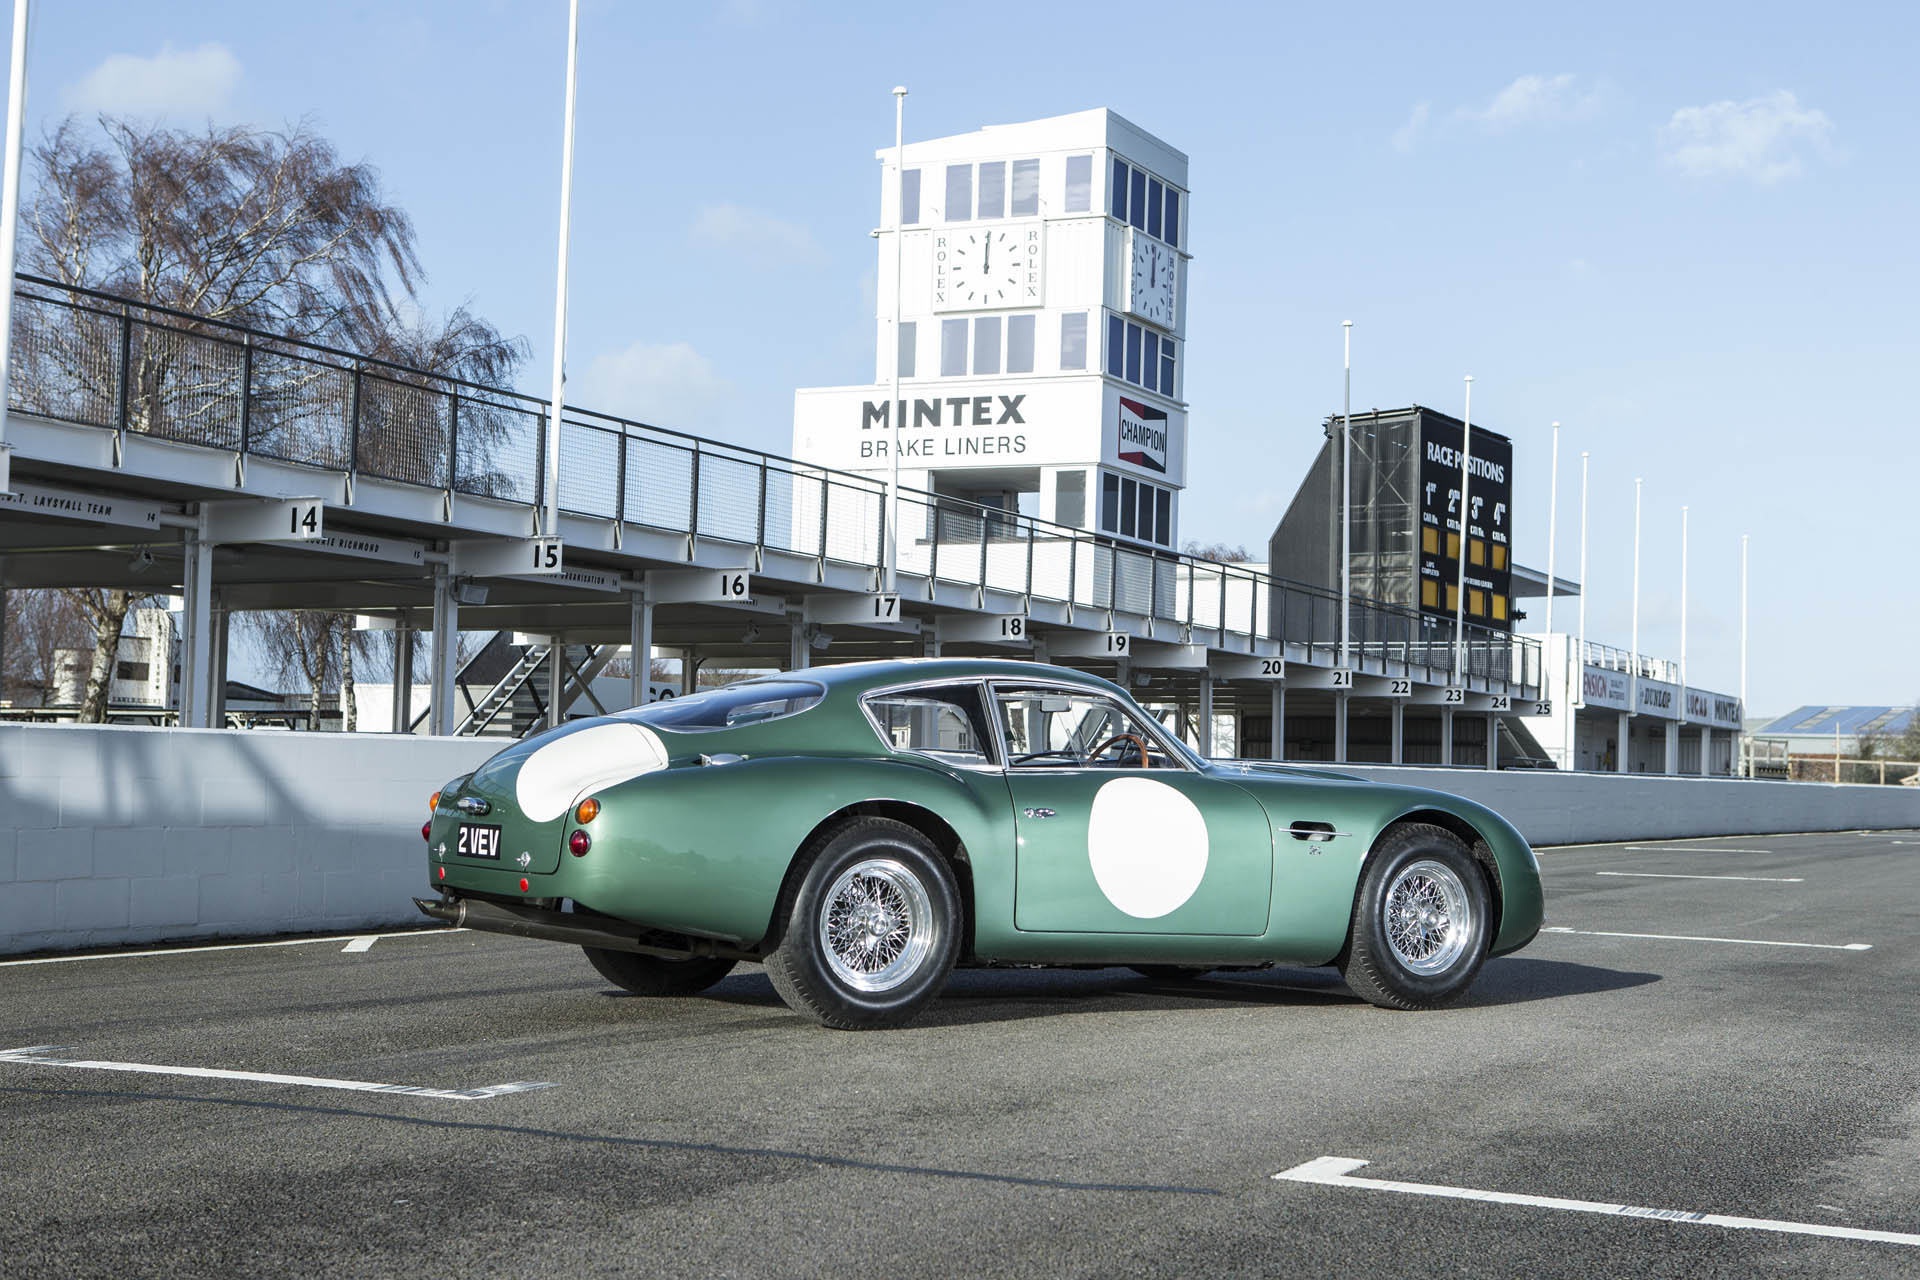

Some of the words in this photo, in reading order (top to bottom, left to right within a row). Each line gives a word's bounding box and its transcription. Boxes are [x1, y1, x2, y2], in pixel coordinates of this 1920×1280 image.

[937, 237, 946, 302] ROLEX
[1028, 230, 1038, 297] ROLEX
[862, 394, 1026, 429] MINTEX
[945, 435, 1027, 456] LINERS
[1121, 419, 1165, 453] CHAMPION
[1427, 441, 1454, 468] RACE
[87, 503, 112, 517] TEAM
[291, 506, 317, 533] 14
[339, 539, 380, 553] RICHMOND
[534, 545, 558, 568] 15
[722, 575, 745, 596] 16
[875, 598, 896, 617] 17
[1002, 618, 1021, 636] 18
[1107, 635, 1127, 652] 19
[1262, 660, 1281, 674] 20
[1333, 671, 1349, 685] 21
[1391, 681, 1409, 693] 22
[1446, 689, 1462, 702] 23
[1491, 697, 1507, 708] 24
[1644, 687, 1672, 709] DUNLOP
[1686, 692, 1707, 717] LUCAS
[1536, 704, 1551, 715] 25
[1714, 699, 1740, 724] MINTEX
[458, 827, 468, 853] 2
[470, 827, 499, 856] VEV
